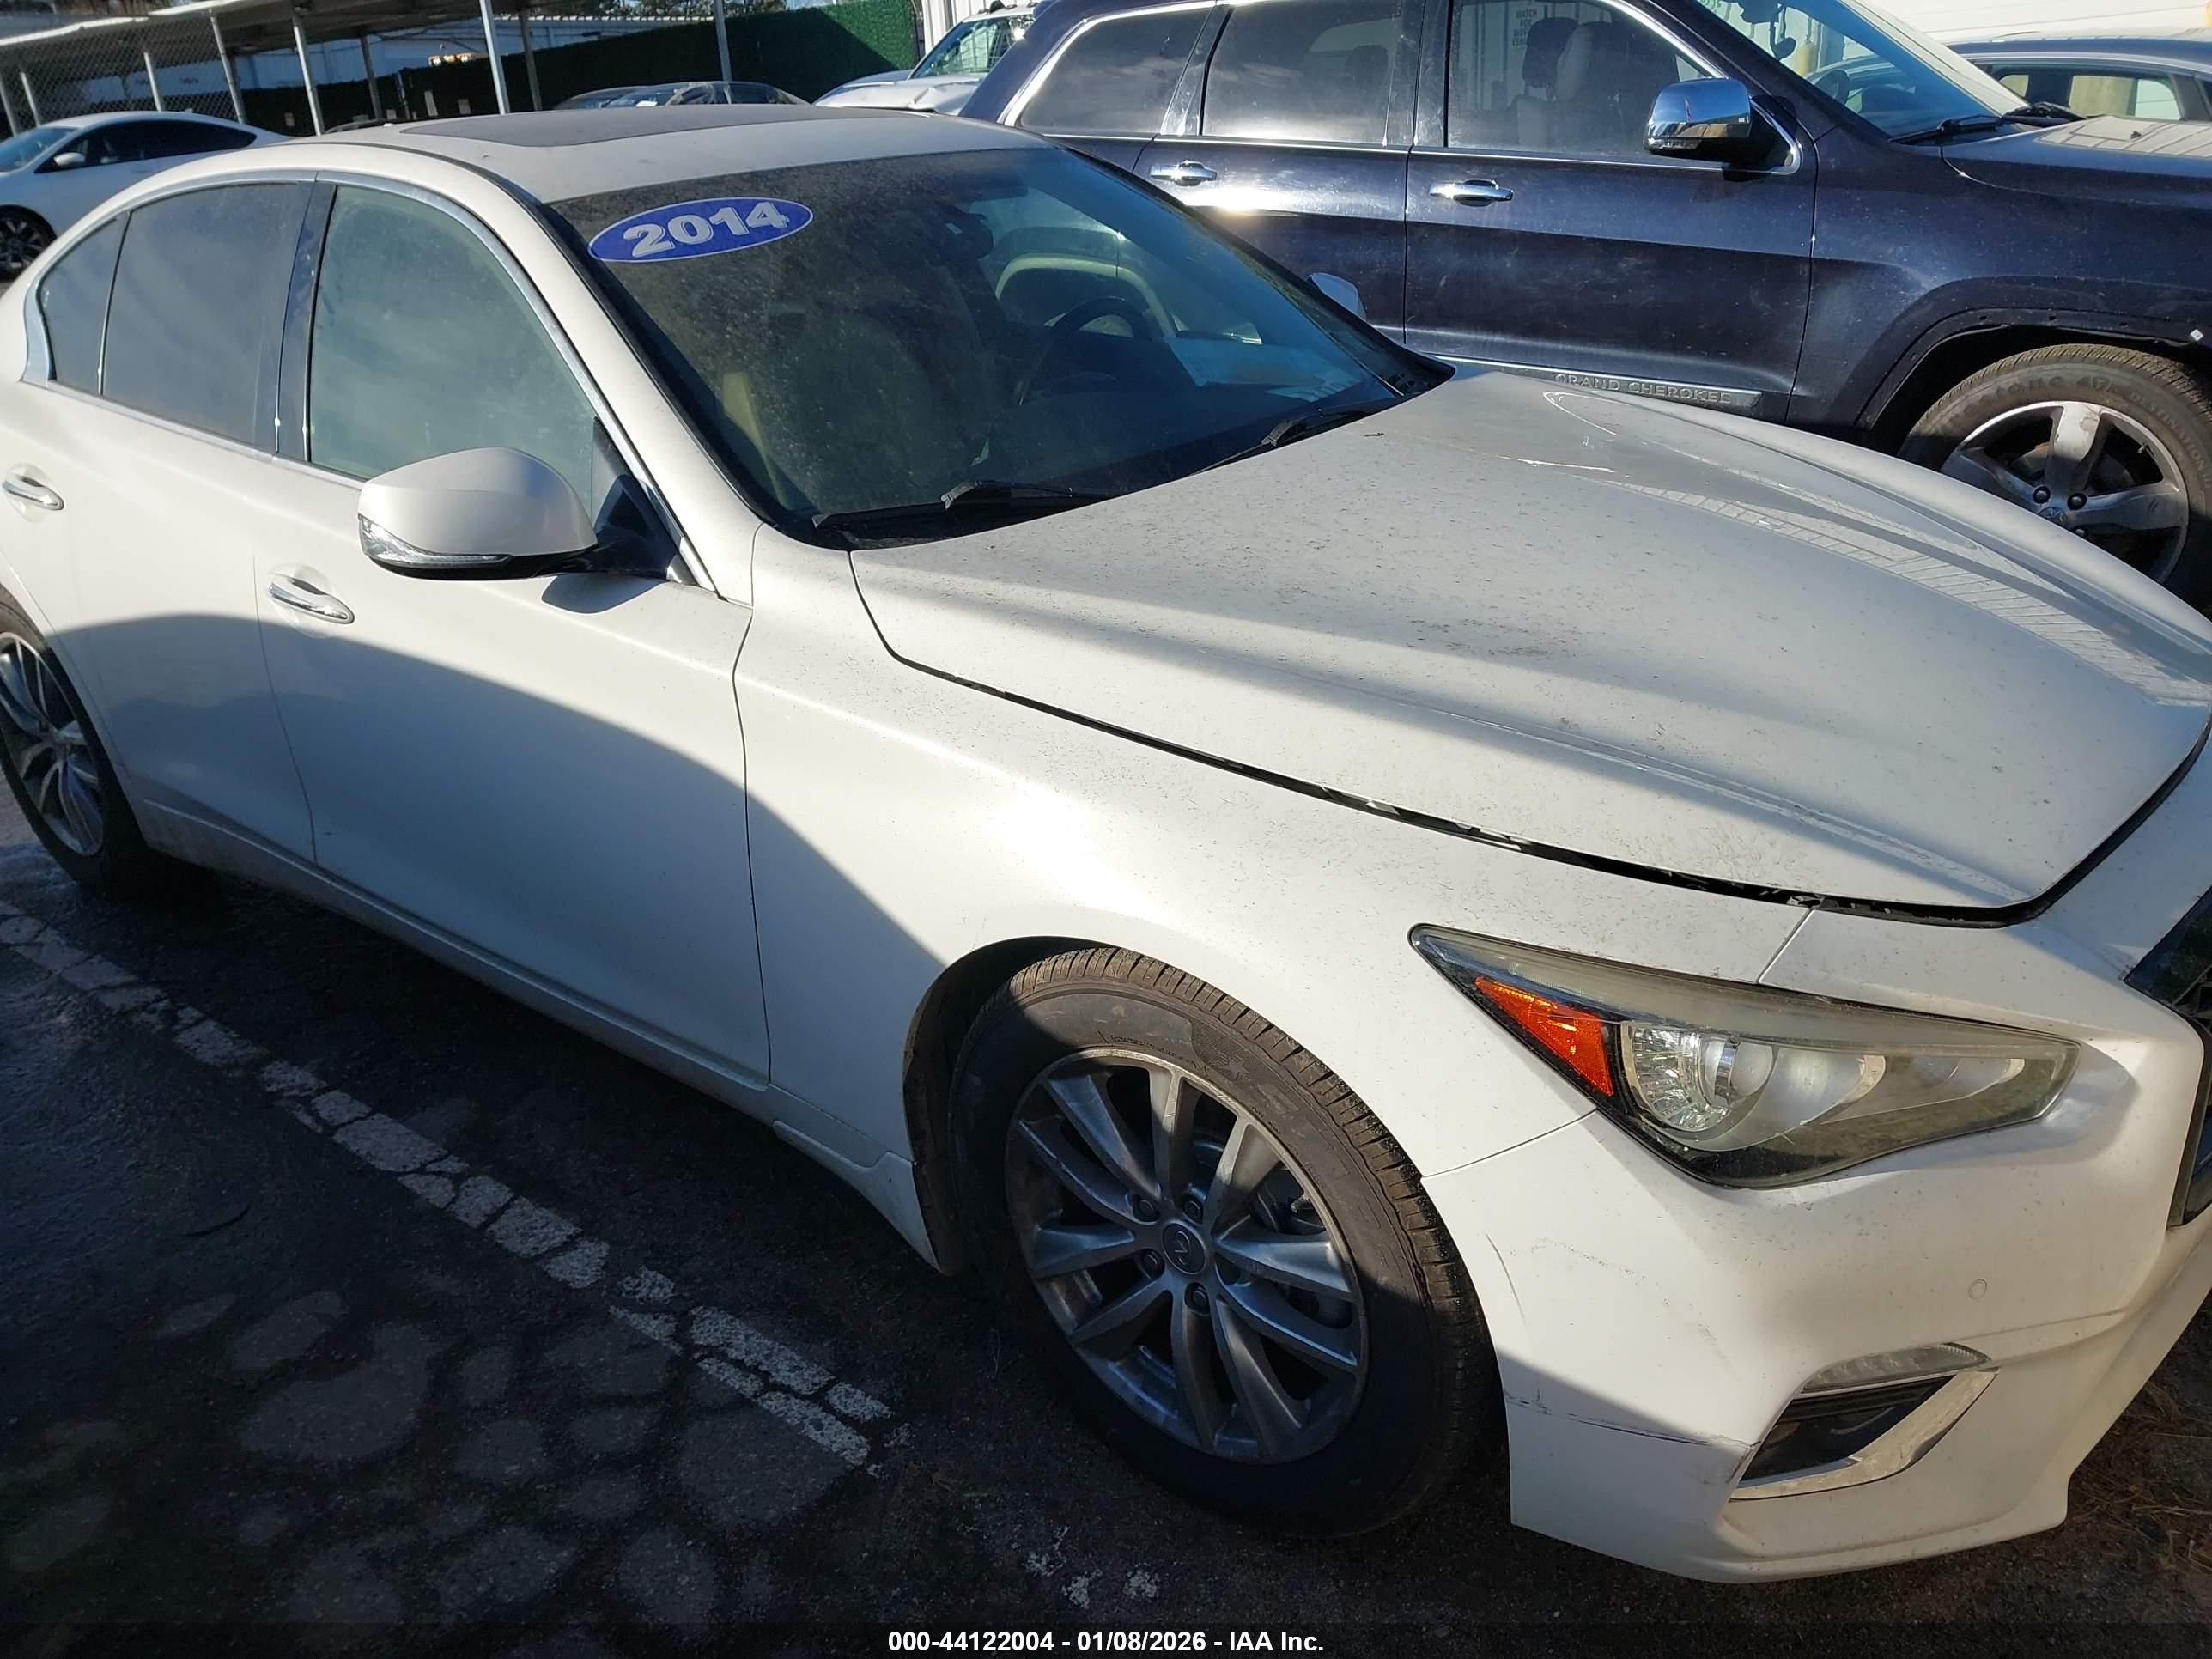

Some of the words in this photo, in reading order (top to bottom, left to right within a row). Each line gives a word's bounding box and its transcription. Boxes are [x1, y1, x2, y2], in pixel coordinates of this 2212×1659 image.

[623, 202, 790, 258] 2014
[1555, 374, 1621, 391] GRAND
[1628, 382, 1731, 403] CHEROKEE
